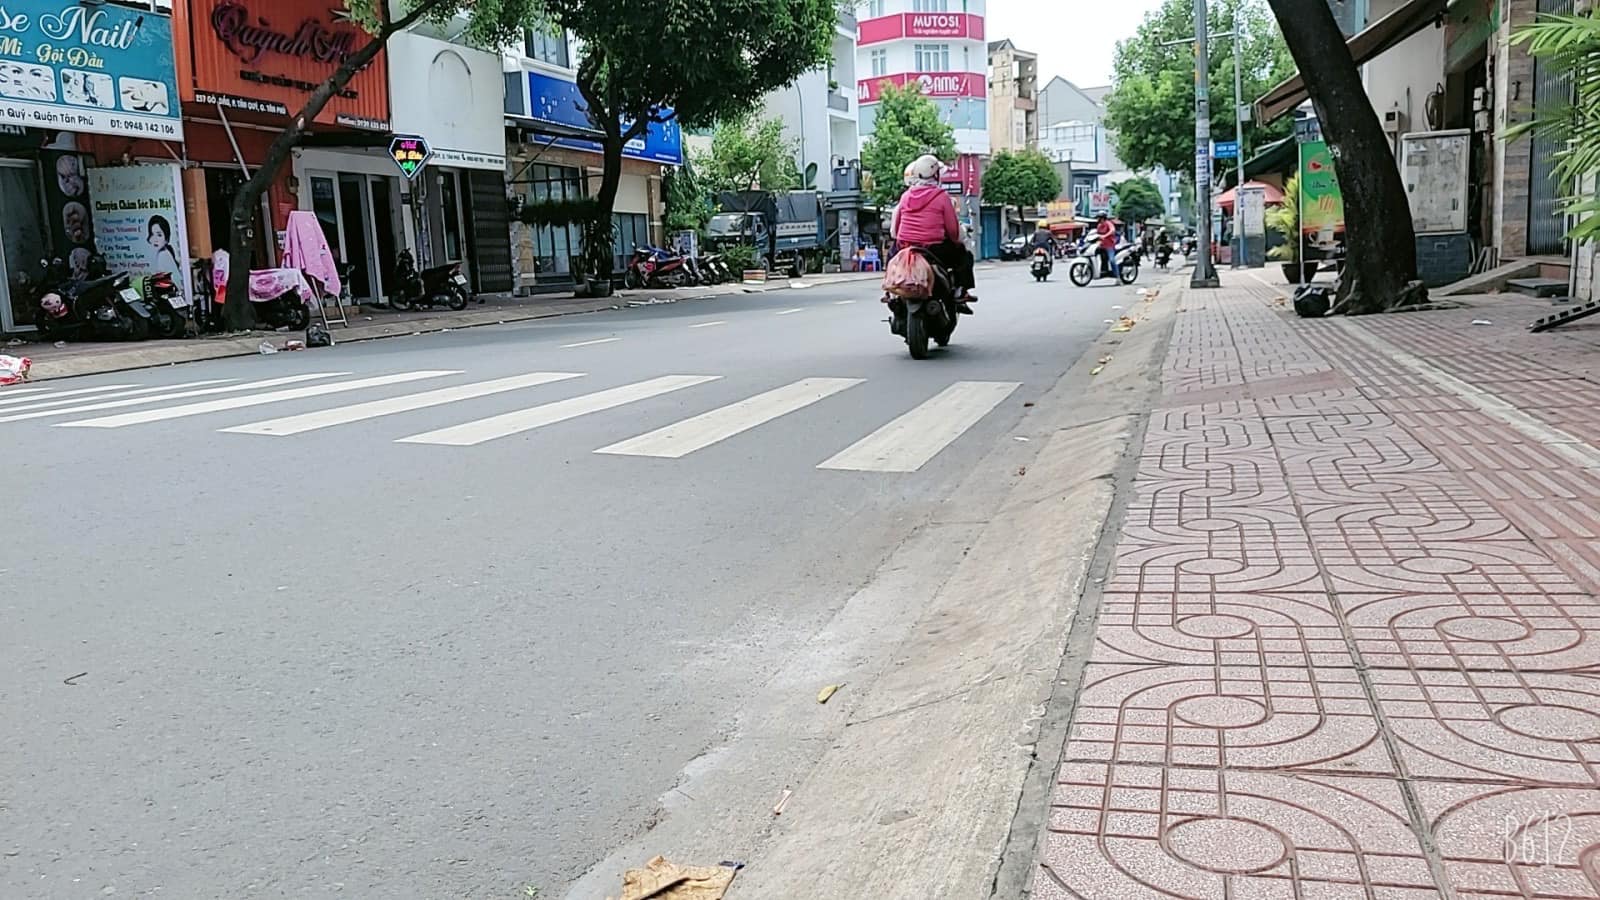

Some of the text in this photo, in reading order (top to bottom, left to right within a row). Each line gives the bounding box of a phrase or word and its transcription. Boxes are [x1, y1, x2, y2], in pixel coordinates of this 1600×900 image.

[40, 7, 133, 49] Nail
[913, 15, 959, 28] MUTOSI
[7, 107, 26, 120] Quý
[33, 111, 58, 124] Quận
[60, 112, 76, 123] Tân
[78, 115, 94, 126] Phú
[124, 120, 144, 131] 0948
[145, 122, 159, 132] 142
[161, 124, 175, 134] 106
